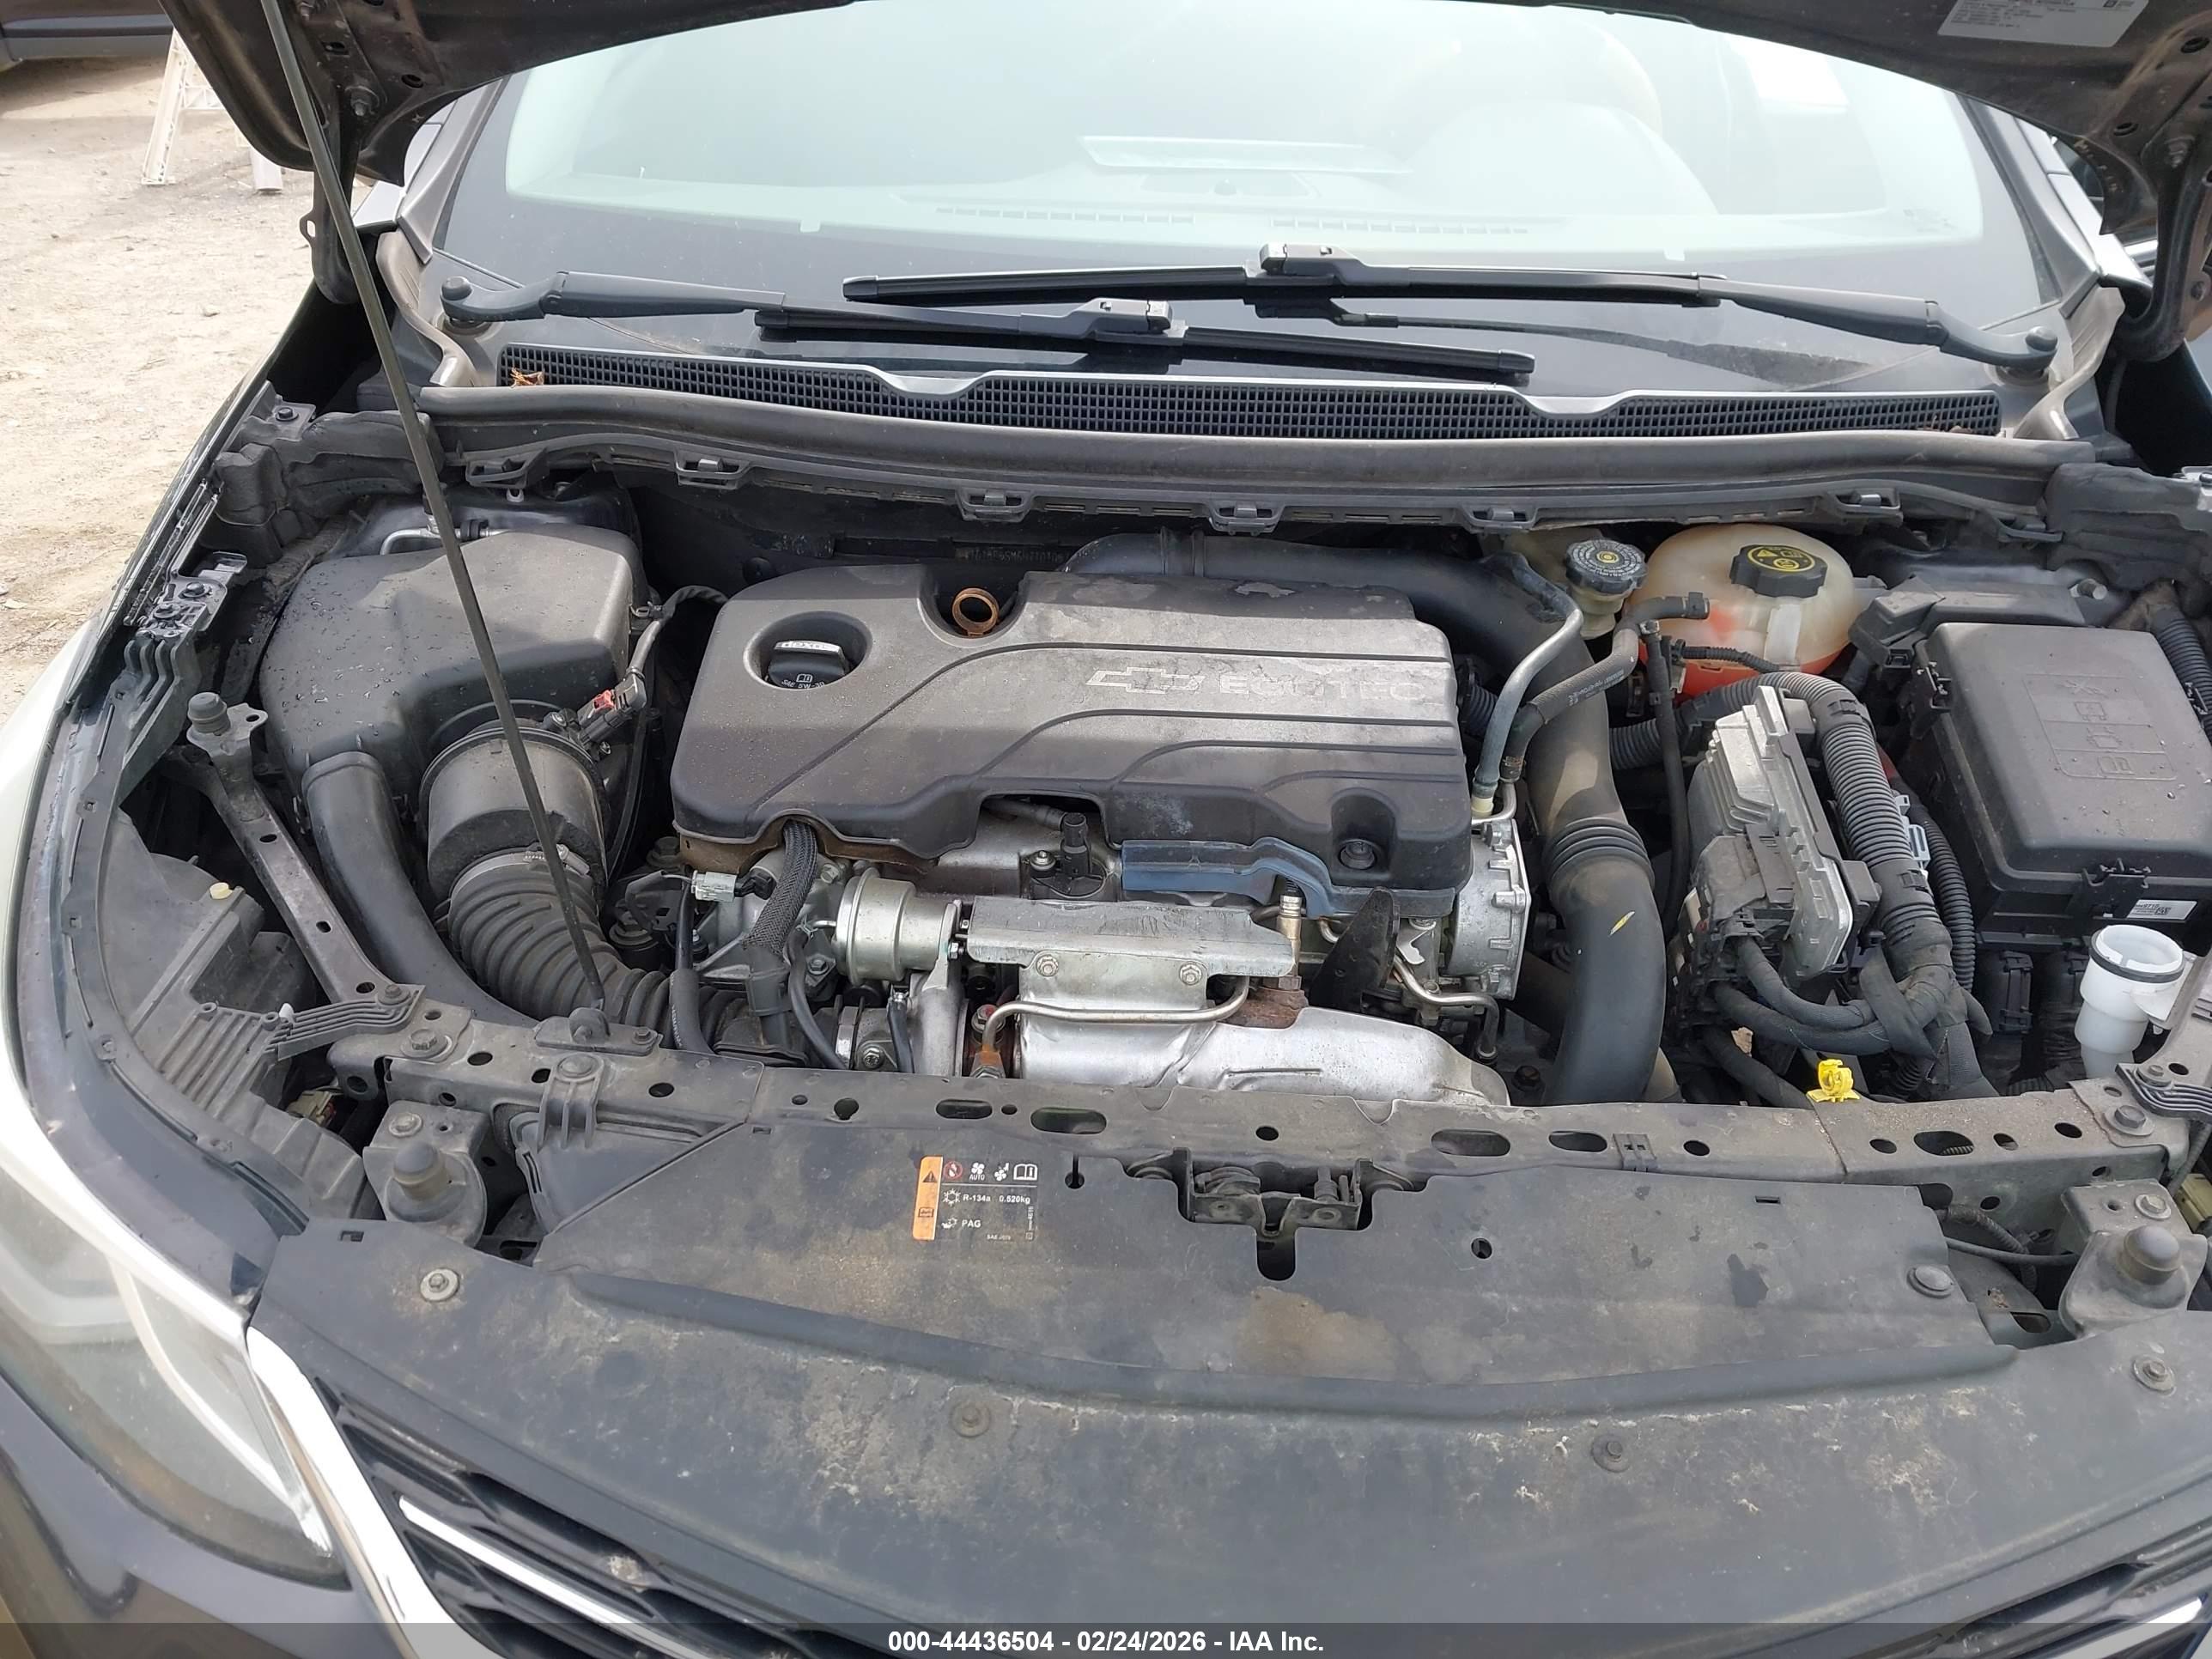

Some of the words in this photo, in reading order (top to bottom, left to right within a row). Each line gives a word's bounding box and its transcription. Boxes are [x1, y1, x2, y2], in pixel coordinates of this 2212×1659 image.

[781, 679, 796, 688] SAE
[963, 1194, 991, 1202] R-134a
[961, 1219, 981, 1228] PAG
